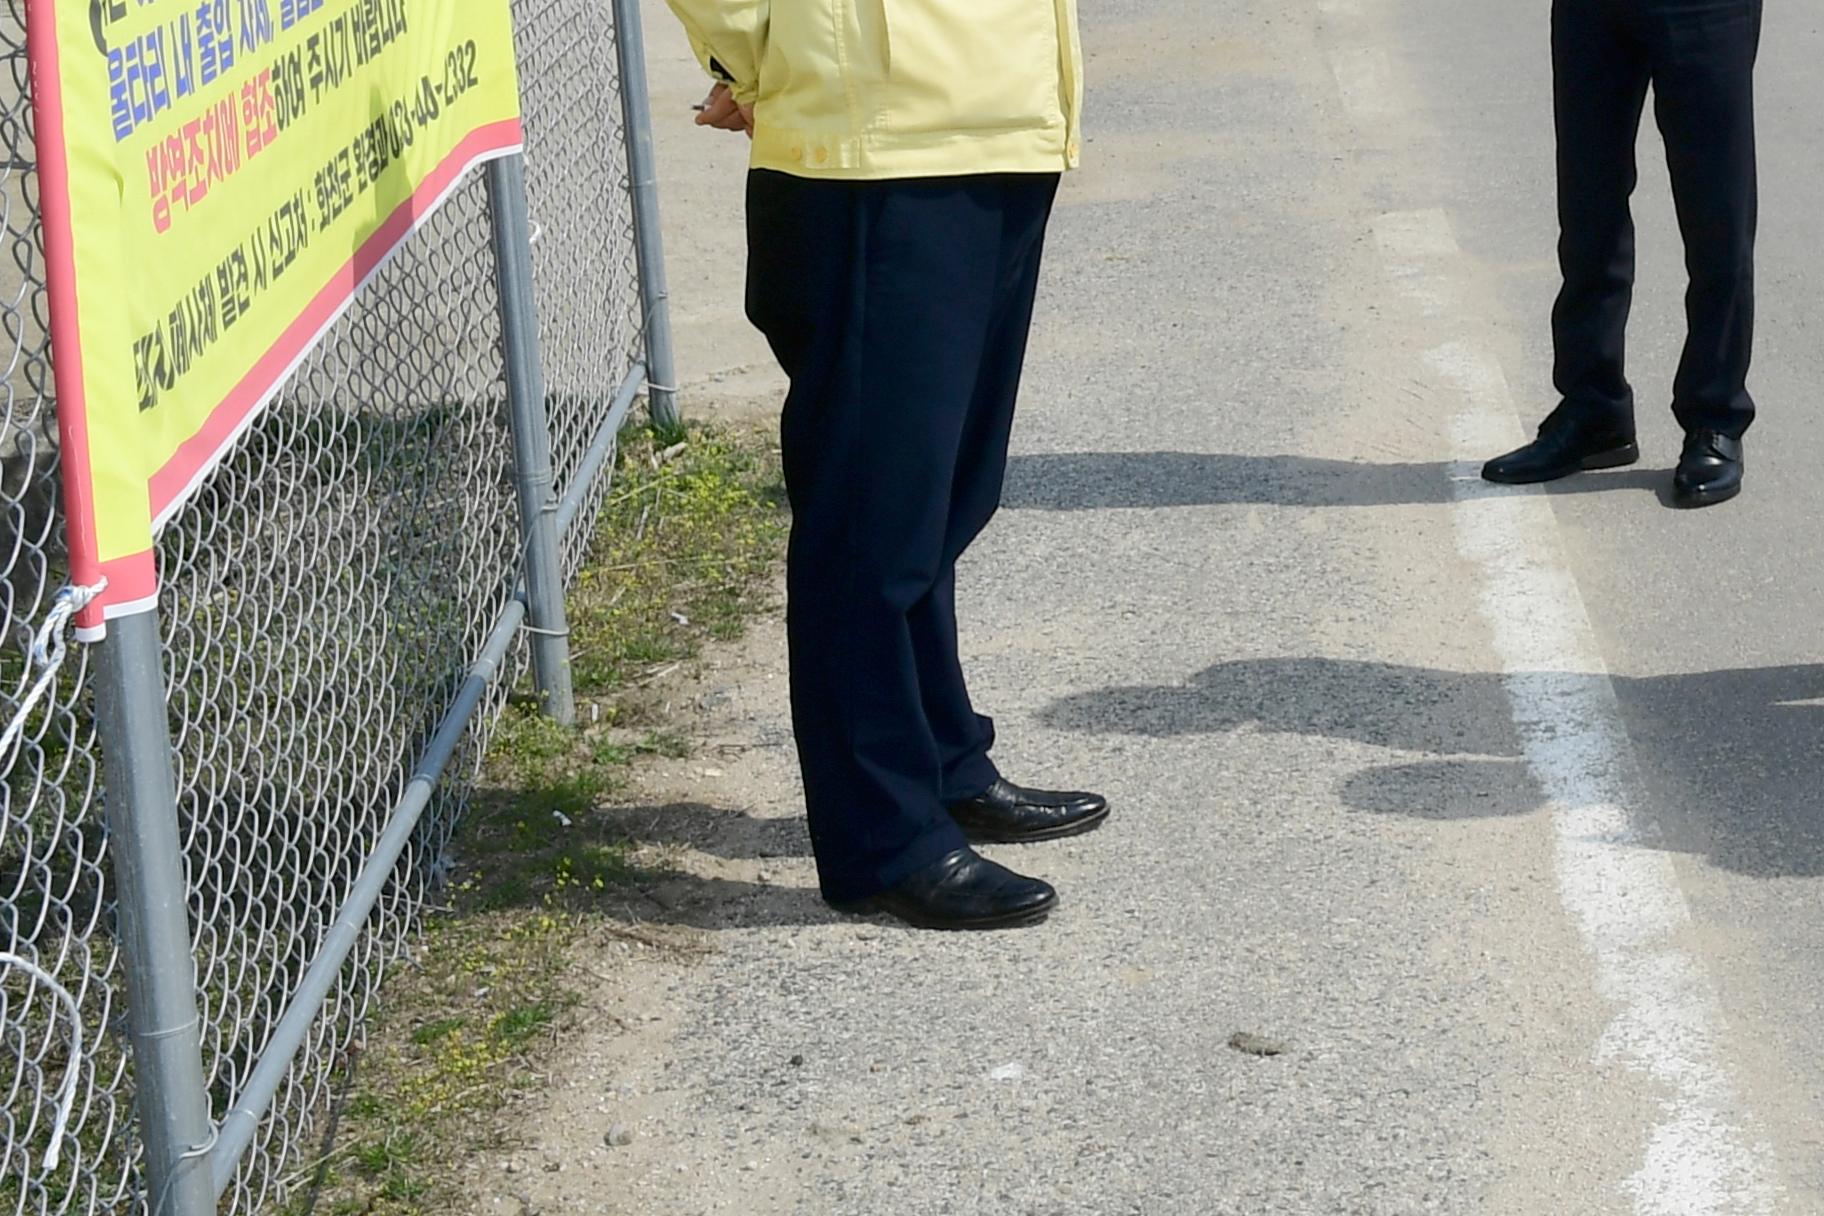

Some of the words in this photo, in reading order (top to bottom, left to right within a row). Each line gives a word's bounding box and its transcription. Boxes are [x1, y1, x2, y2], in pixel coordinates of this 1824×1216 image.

[107, 25, 171, 143] 울타리
[170, 12, 195, 98] 내
[146, 91, 240, 234] 방역조치에
[241, 45, 306, 160] 협조하여
[307, 11, 352, 104] 주시기
[217, 242, 250, 332] 발견
[251, 226, 267, 295] 시
[268, 187, 309, 280] 신고처
[307, 190, 315, 232] :
[314, 146, 353, 233] 화천군
[353, 114, 389, 194] 환경과
